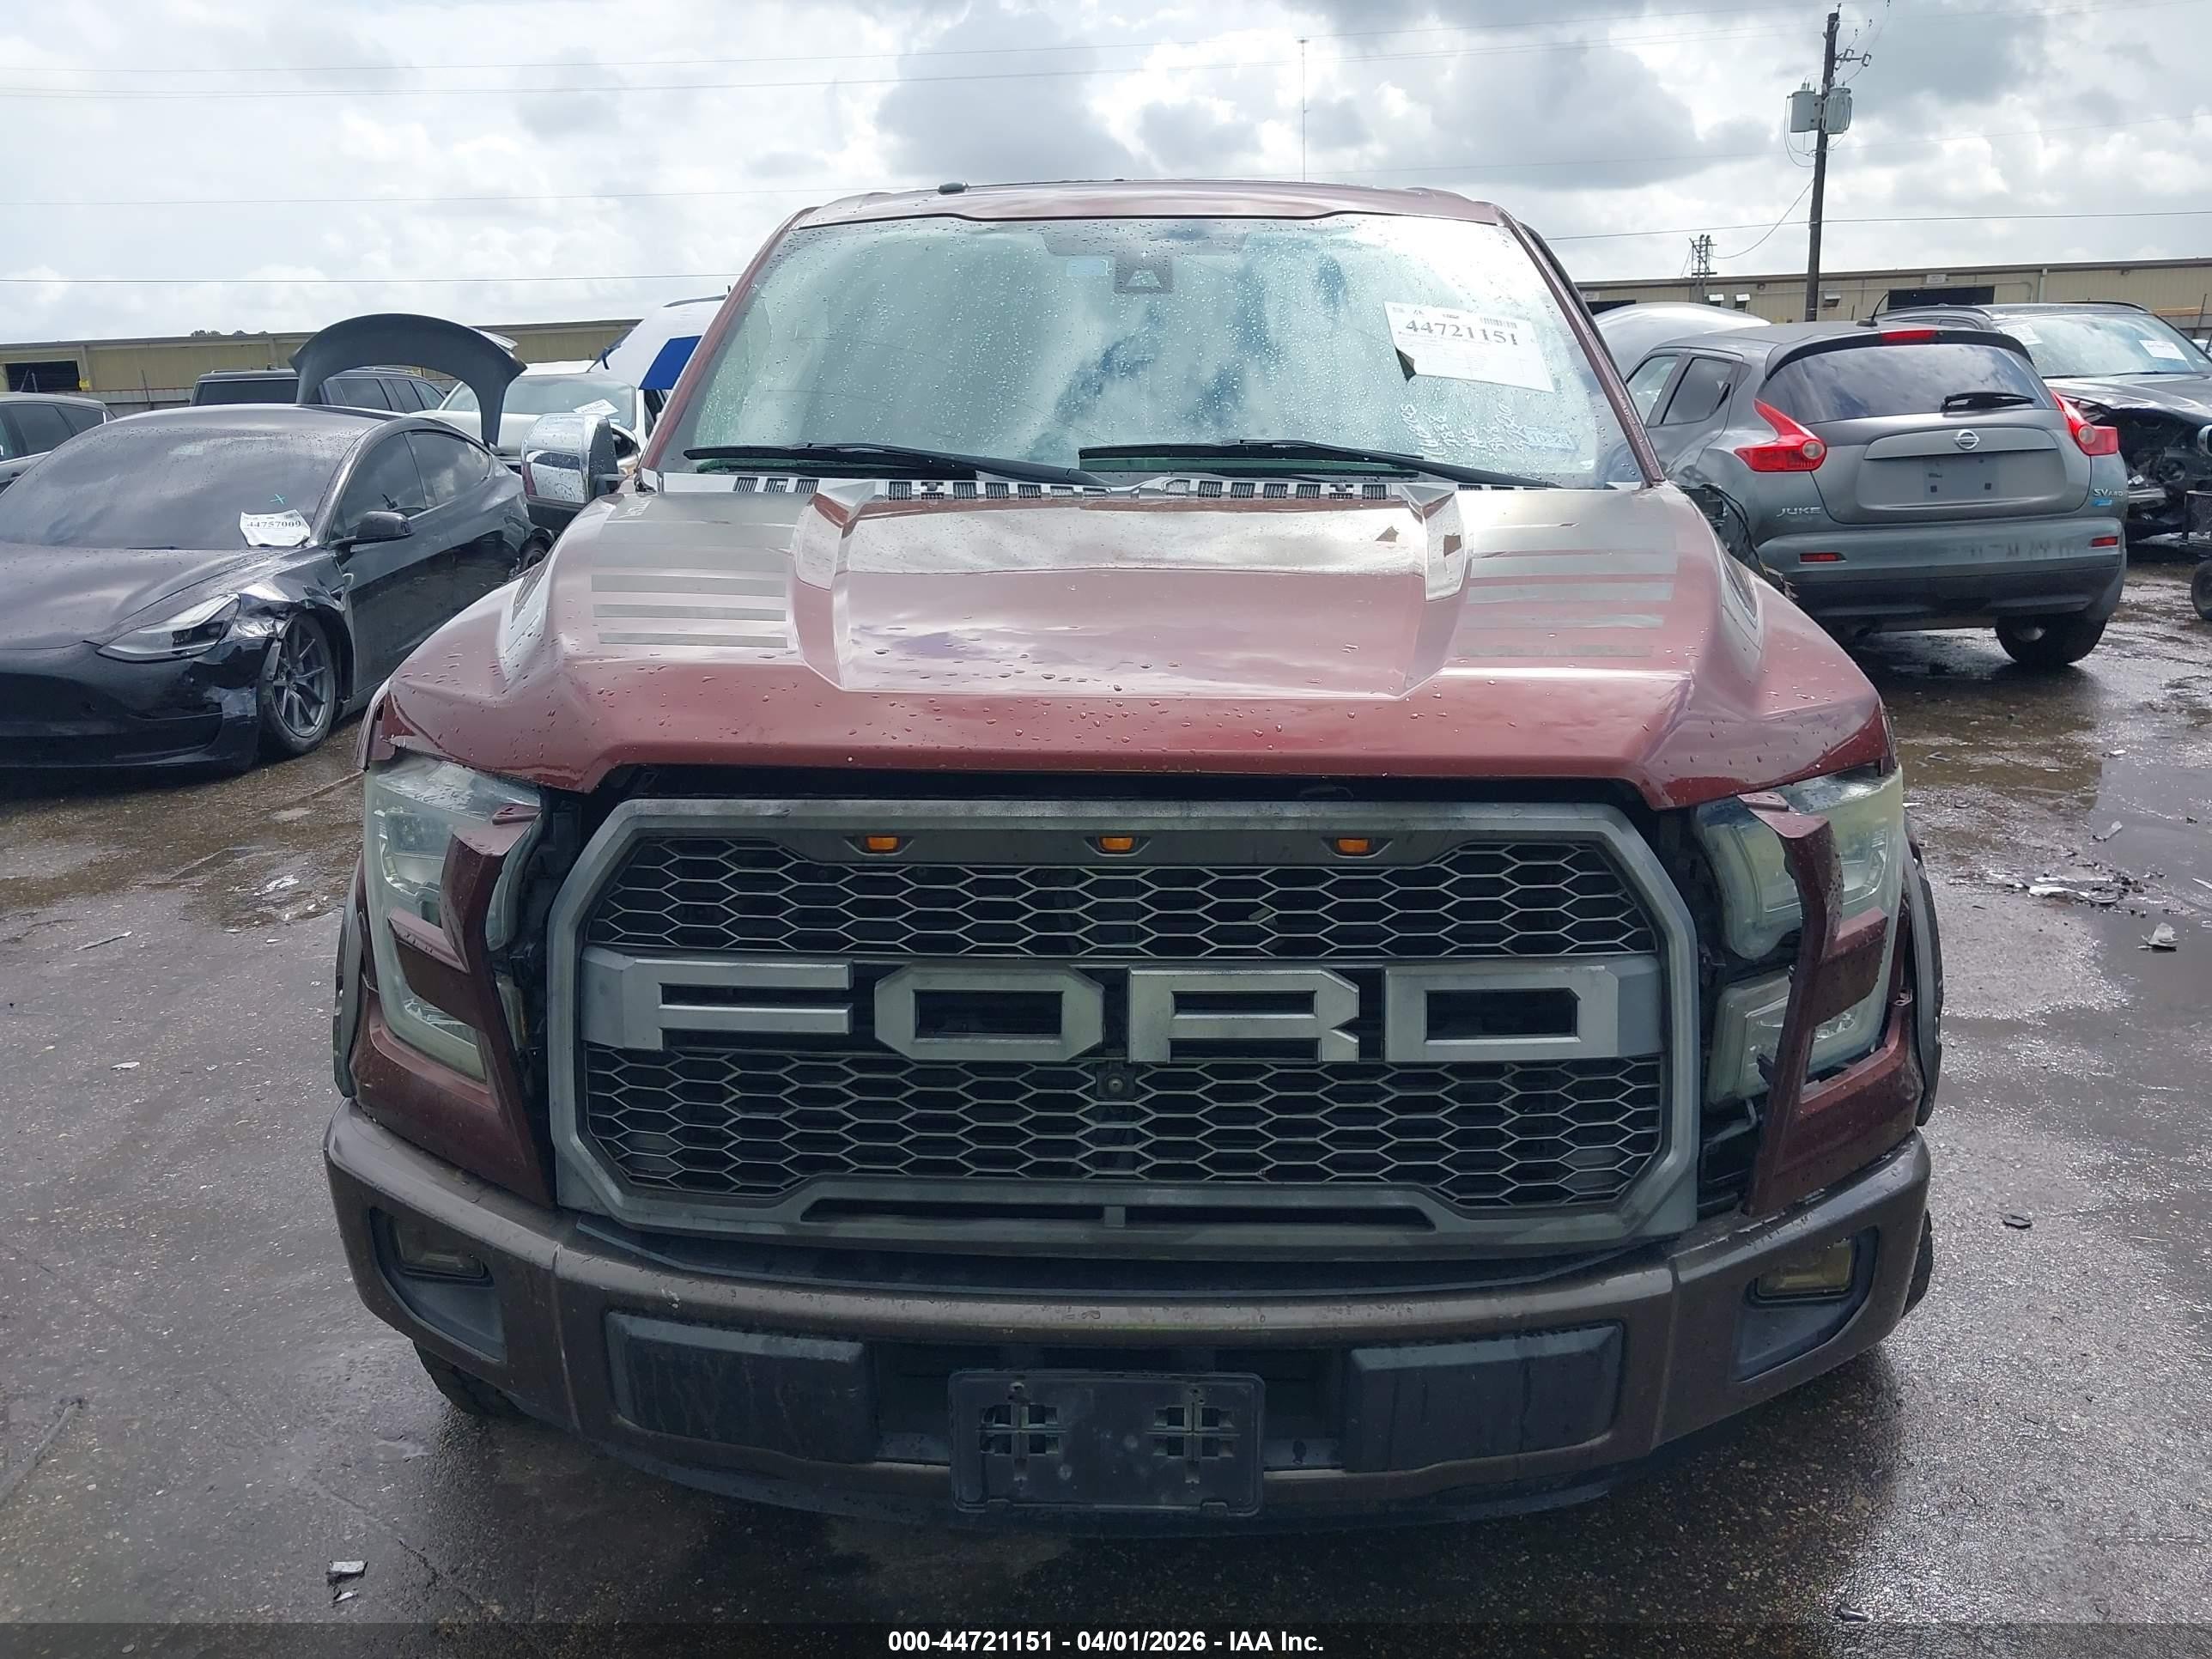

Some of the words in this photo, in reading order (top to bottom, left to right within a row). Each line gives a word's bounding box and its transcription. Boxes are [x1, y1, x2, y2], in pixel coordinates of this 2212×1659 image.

[1405, 319, 1518, 346] 44721151
[2093, 488, 2109, 496] SV
[1776, 507, 1821, 518] JUKE
[605, 957, 1632, 1063] FORD
